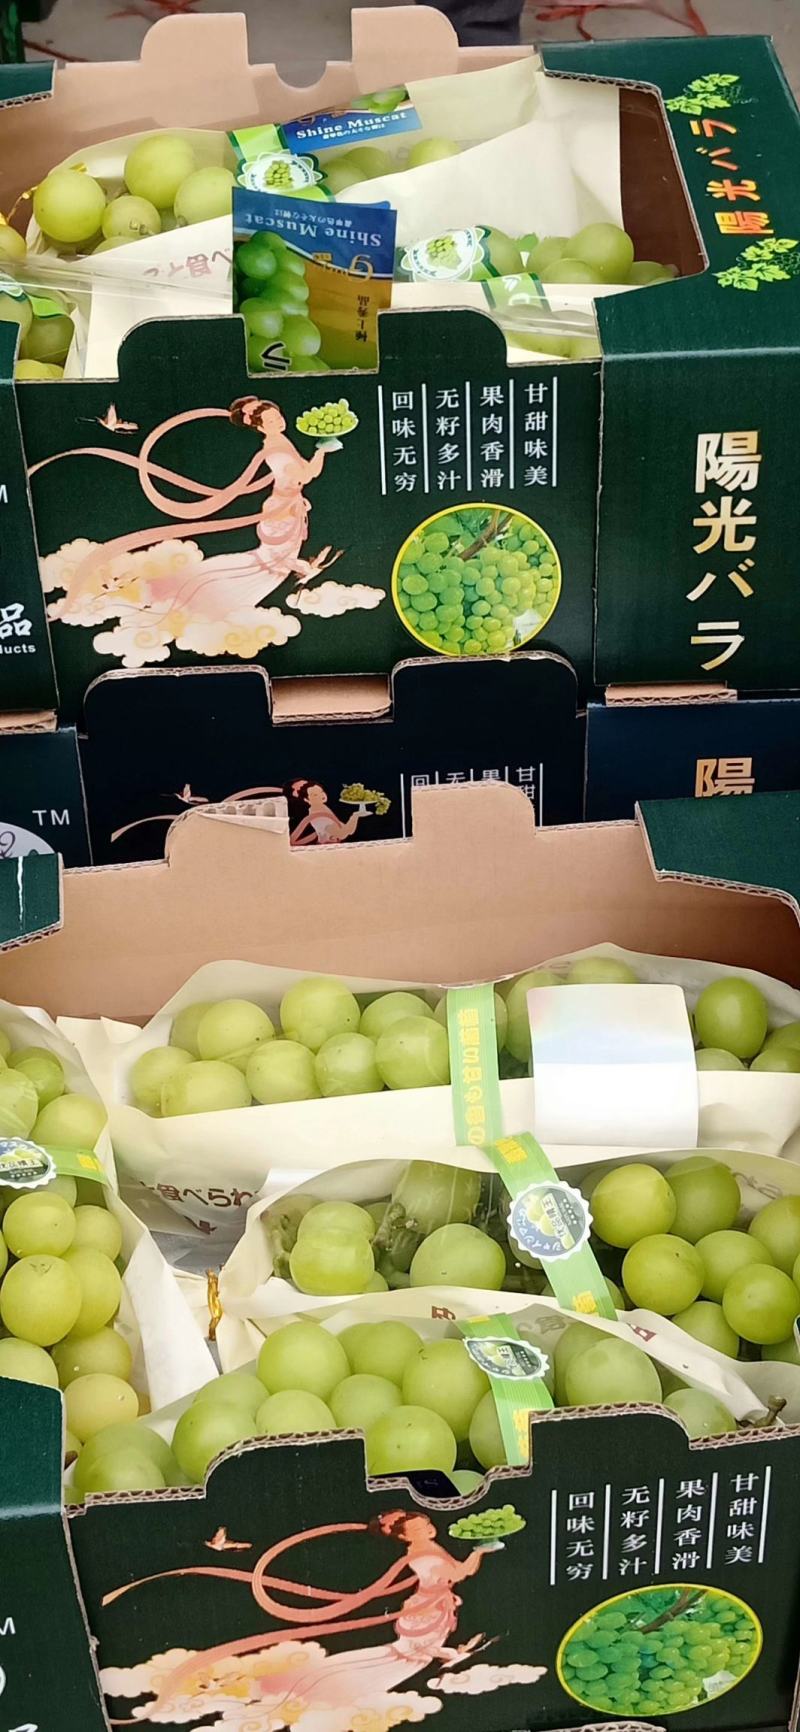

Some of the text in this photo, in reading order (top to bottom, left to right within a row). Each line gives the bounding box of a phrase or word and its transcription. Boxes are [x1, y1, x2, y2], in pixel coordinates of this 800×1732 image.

[296, 124, 342, 139] Shine
[347, 112, 408, 129] Muscat
[689, 118, 774, 234] 陽光バラ
[245, 213, 382, 247] Shine Muscat
[391, 390, 417, 493] 回味无穷
[435, 388, 461, 490] 无籽多汁
[480, 385, 504, 488] 果肉香滑
[523, 382, 549, 487] 甘甜味美
[686, 430, 763, 671] 陽光バラ
[31, 809, 71, 826] TM
[694, 756, 756, 798] 陽
[565, 1491, 596, 1582] 回味无穷
[618, 1485, 650, 1576] 无籽多汁
[671, 1478, 705, 1570] 果肉香滑
[724, 1472, 760, 1565] 甘甜味美
